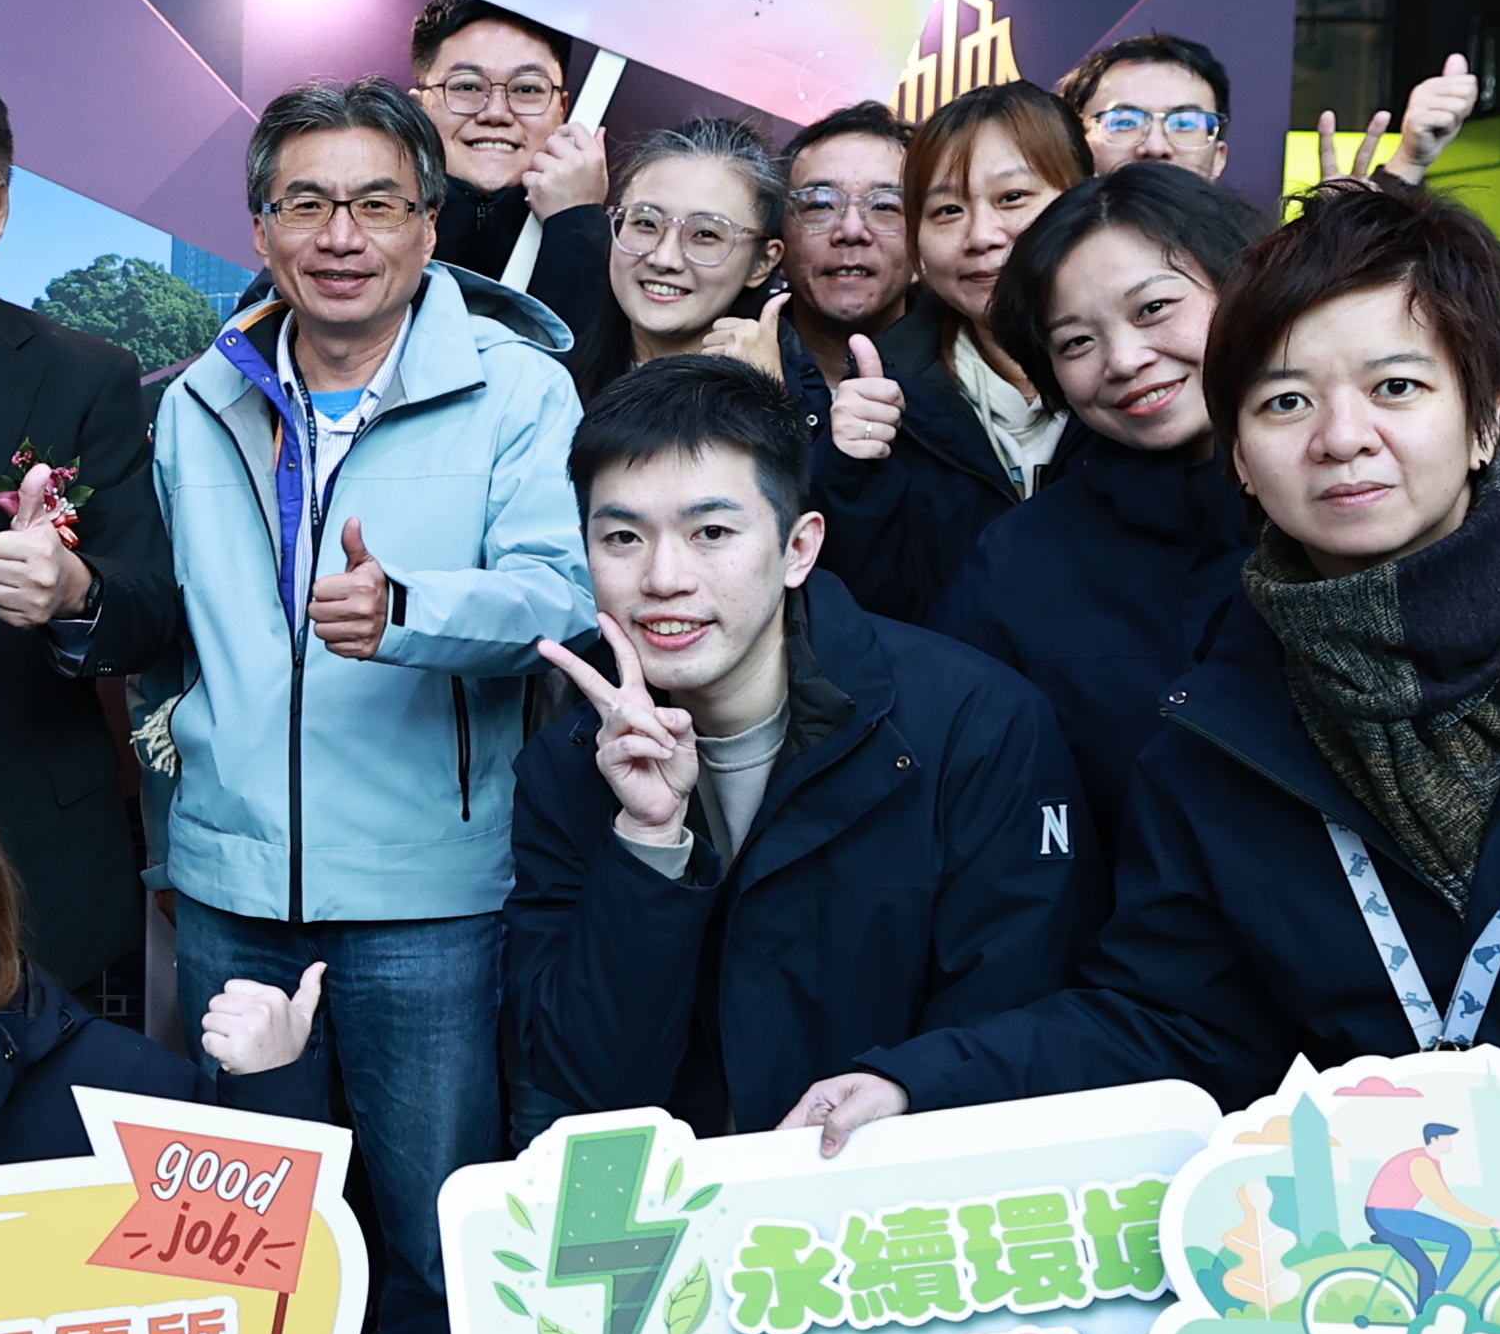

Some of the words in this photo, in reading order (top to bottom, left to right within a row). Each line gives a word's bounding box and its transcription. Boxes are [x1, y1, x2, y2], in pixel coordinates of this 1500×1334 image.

[1040, 804, 1069, 854] N
[151, 1141, 293, 1217] good
[158, 1201, 269, 1276] job!
